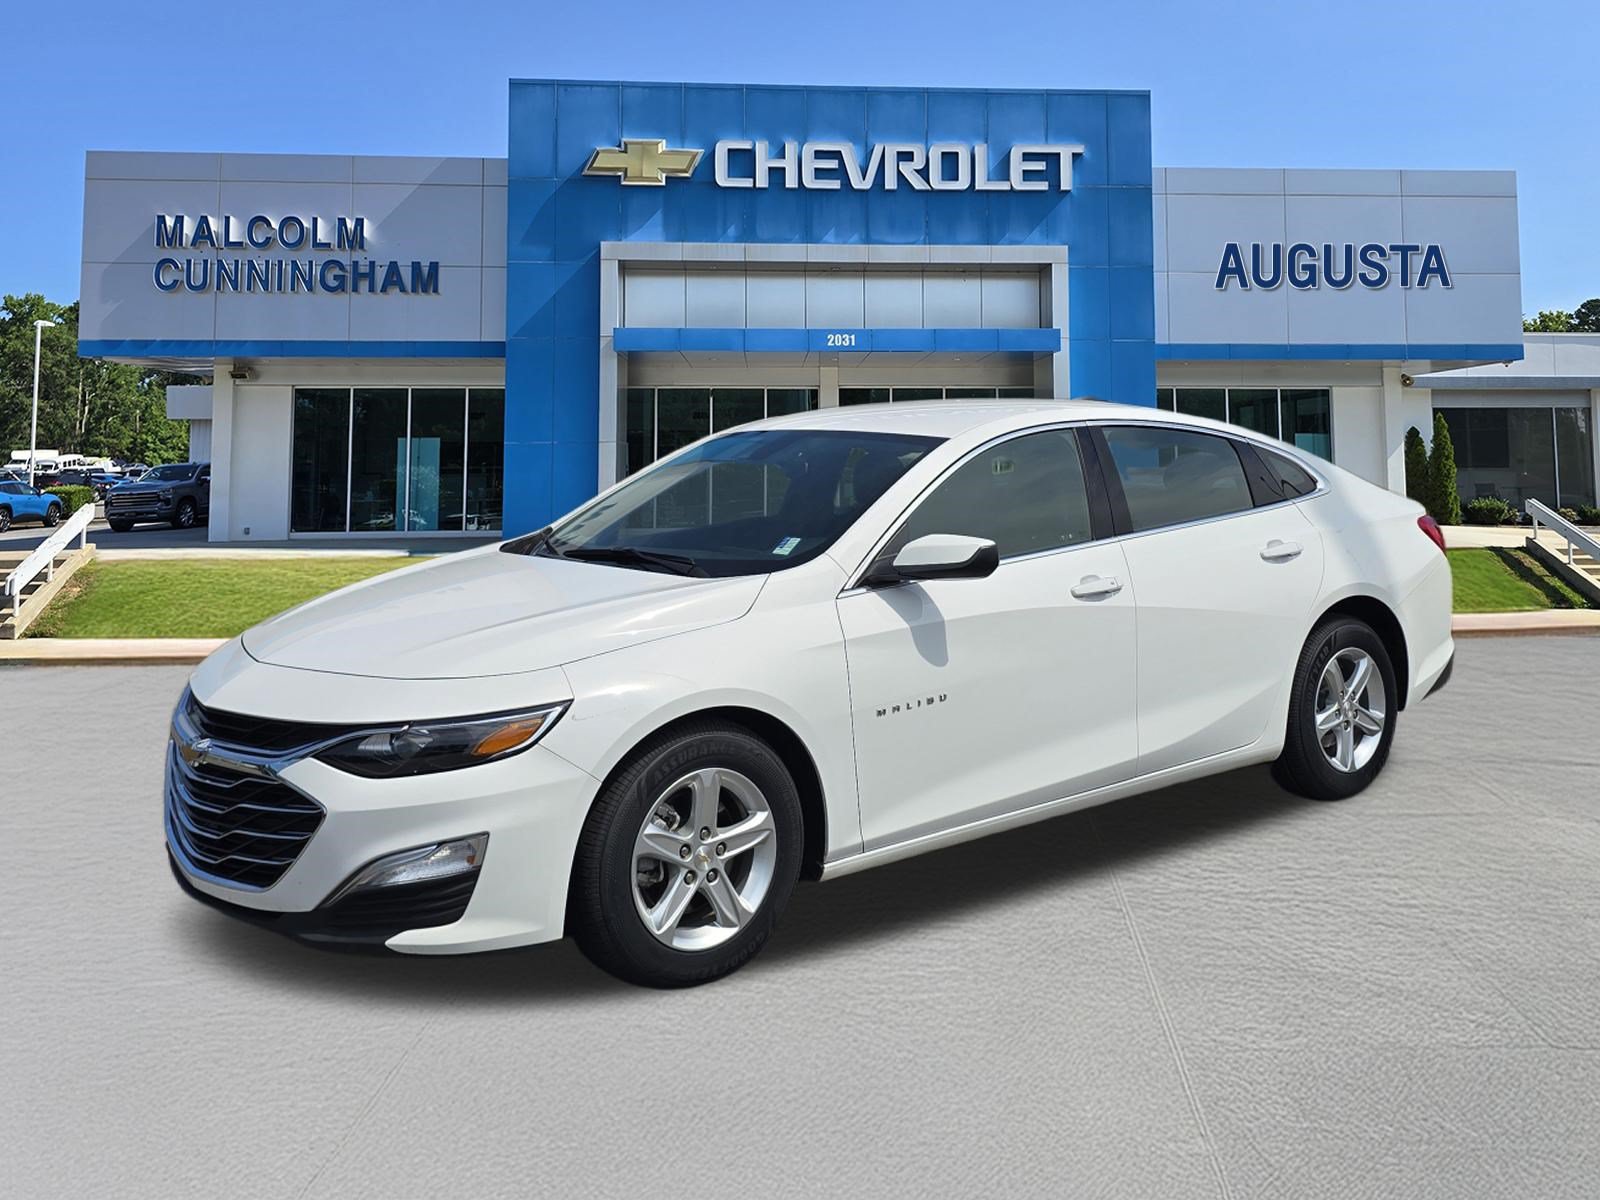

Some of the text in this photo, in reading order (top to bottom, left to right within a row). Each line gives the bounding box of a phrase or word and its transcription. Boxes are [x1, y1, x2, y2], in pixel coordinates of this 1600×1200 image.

[714, 139, 1084, 192] CHEVROLET
[154, 214, 367, 251] MALCOLM
[153, 257, 441, 295] CUNNINGHAM
[1214, 241, 1452, 290] AUGUSTA
[827, 333, 856, 347] 2031
[876, 693, 948, 717] MALIBU
